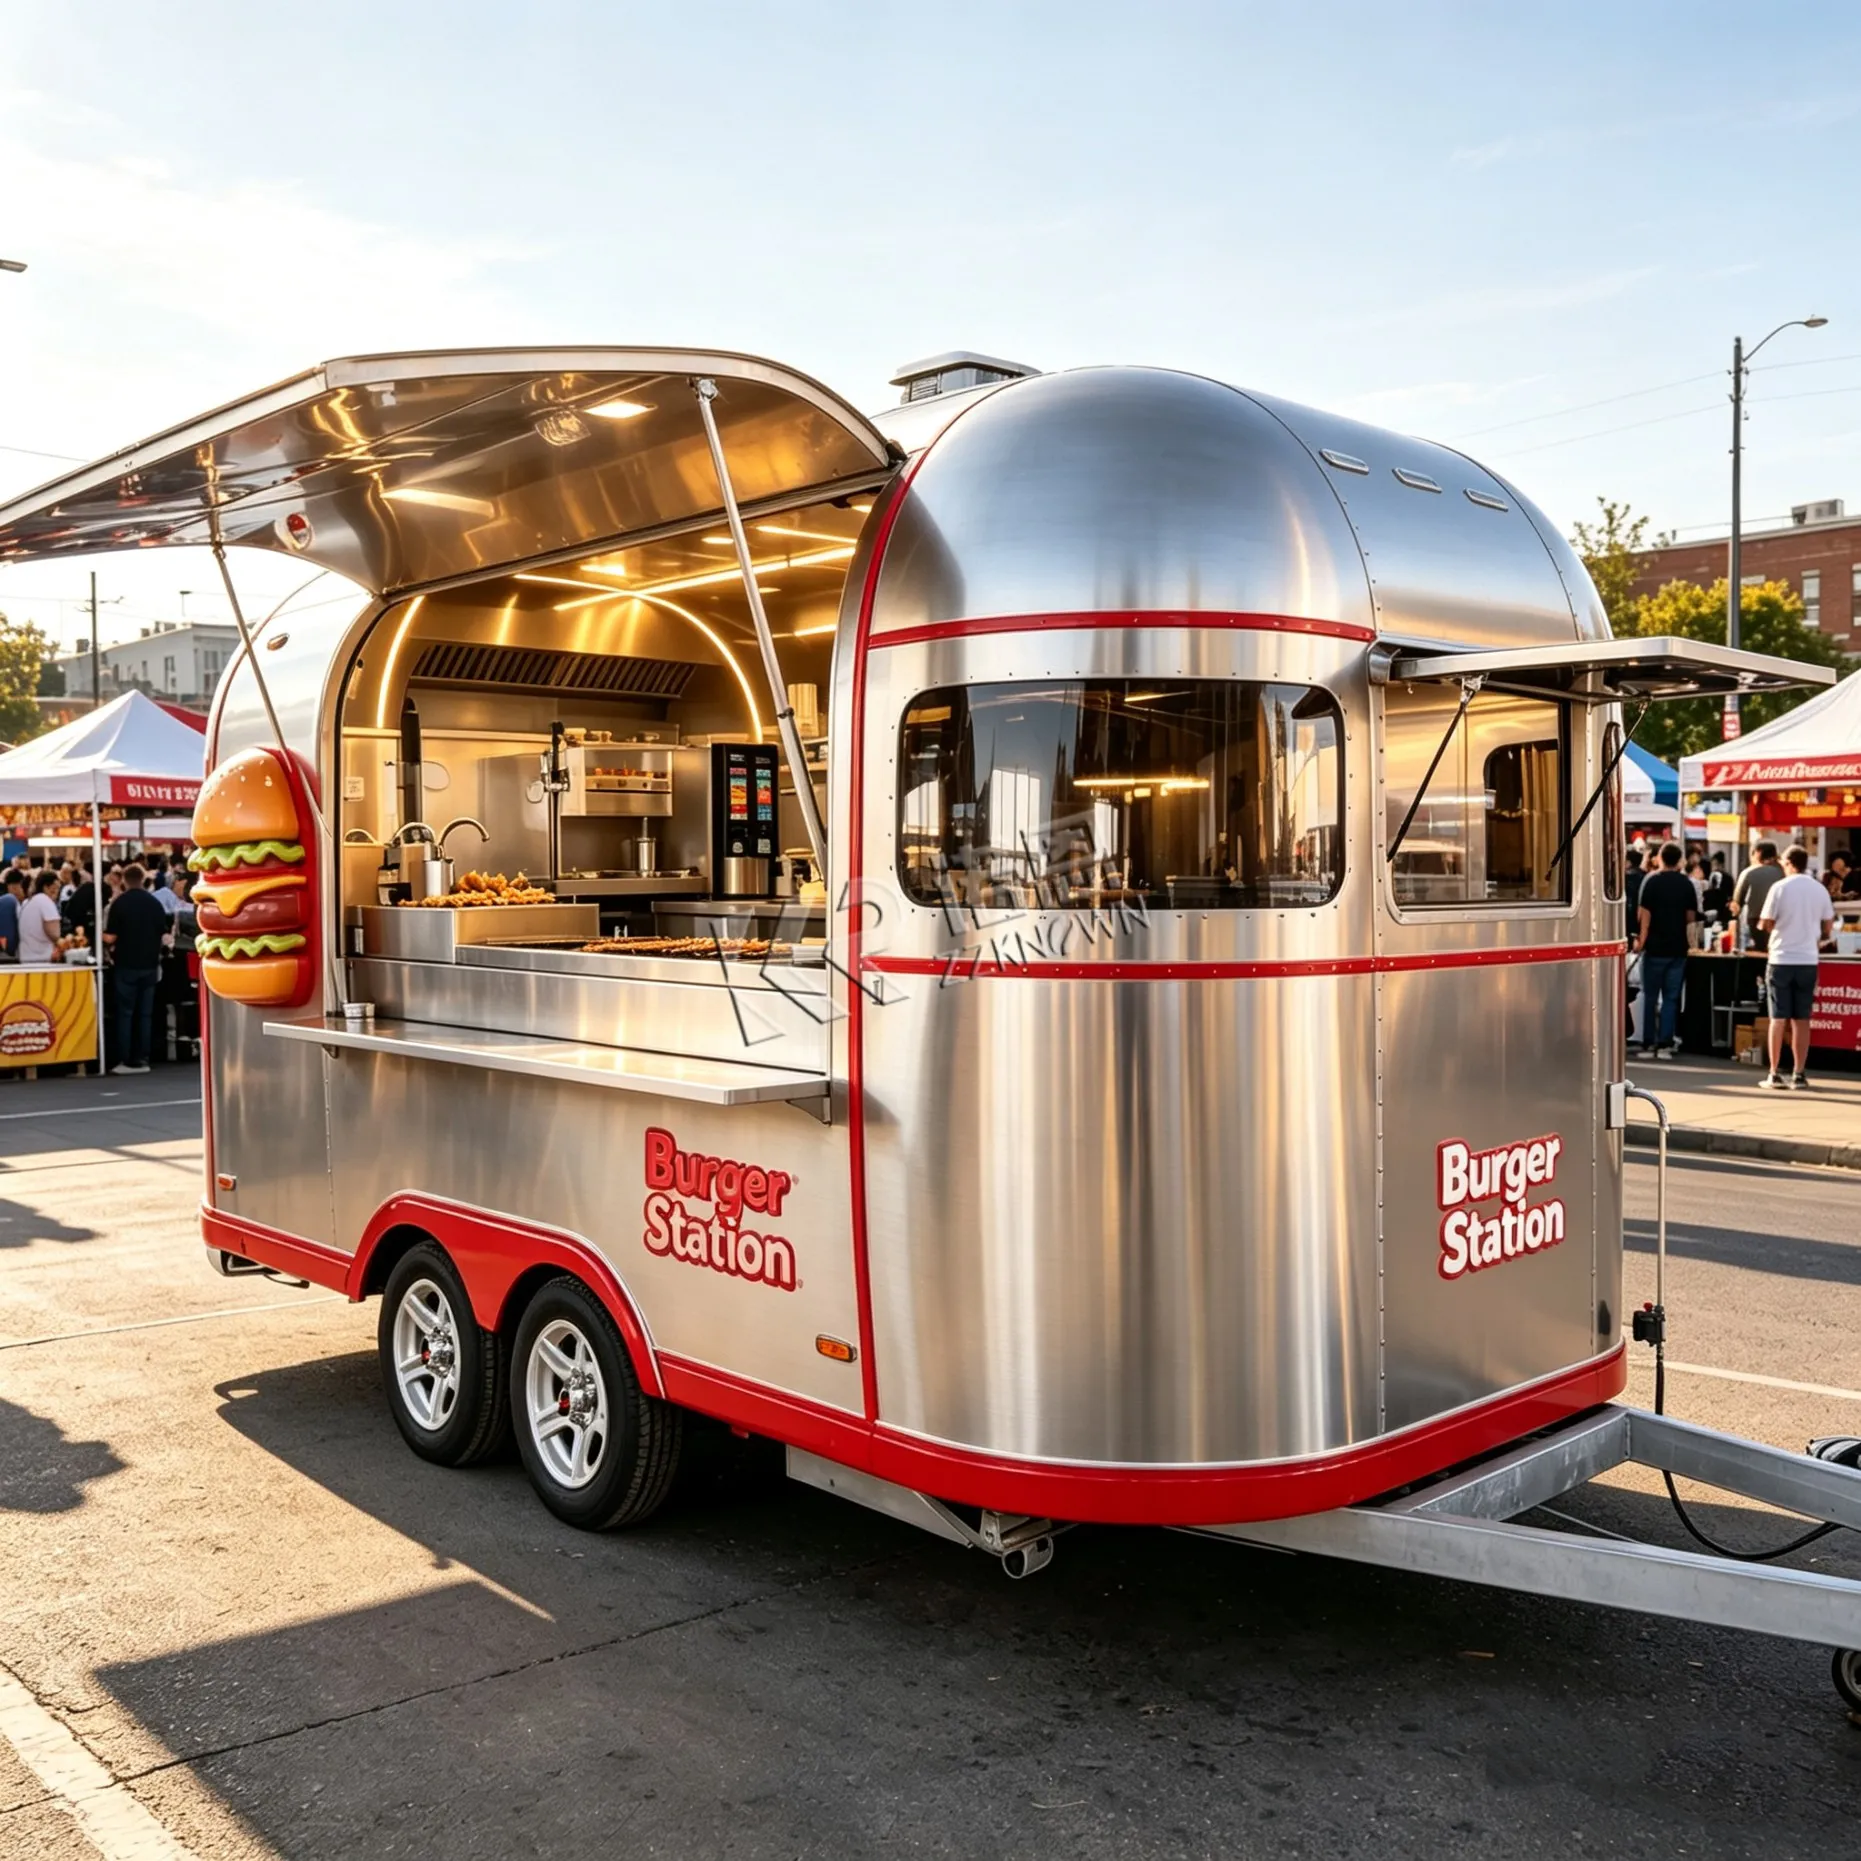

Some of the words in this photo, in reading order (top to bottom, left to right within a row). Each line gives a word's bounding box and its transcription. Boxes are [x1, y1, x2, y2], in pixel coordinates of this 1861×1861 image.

[645, 1127, 791, 1222] Burger
[1438, 1133, 1562, 1209] Burger
[644, 1192, 796, 1292] Station
[1439, 1198, 1565, 1280] Station
